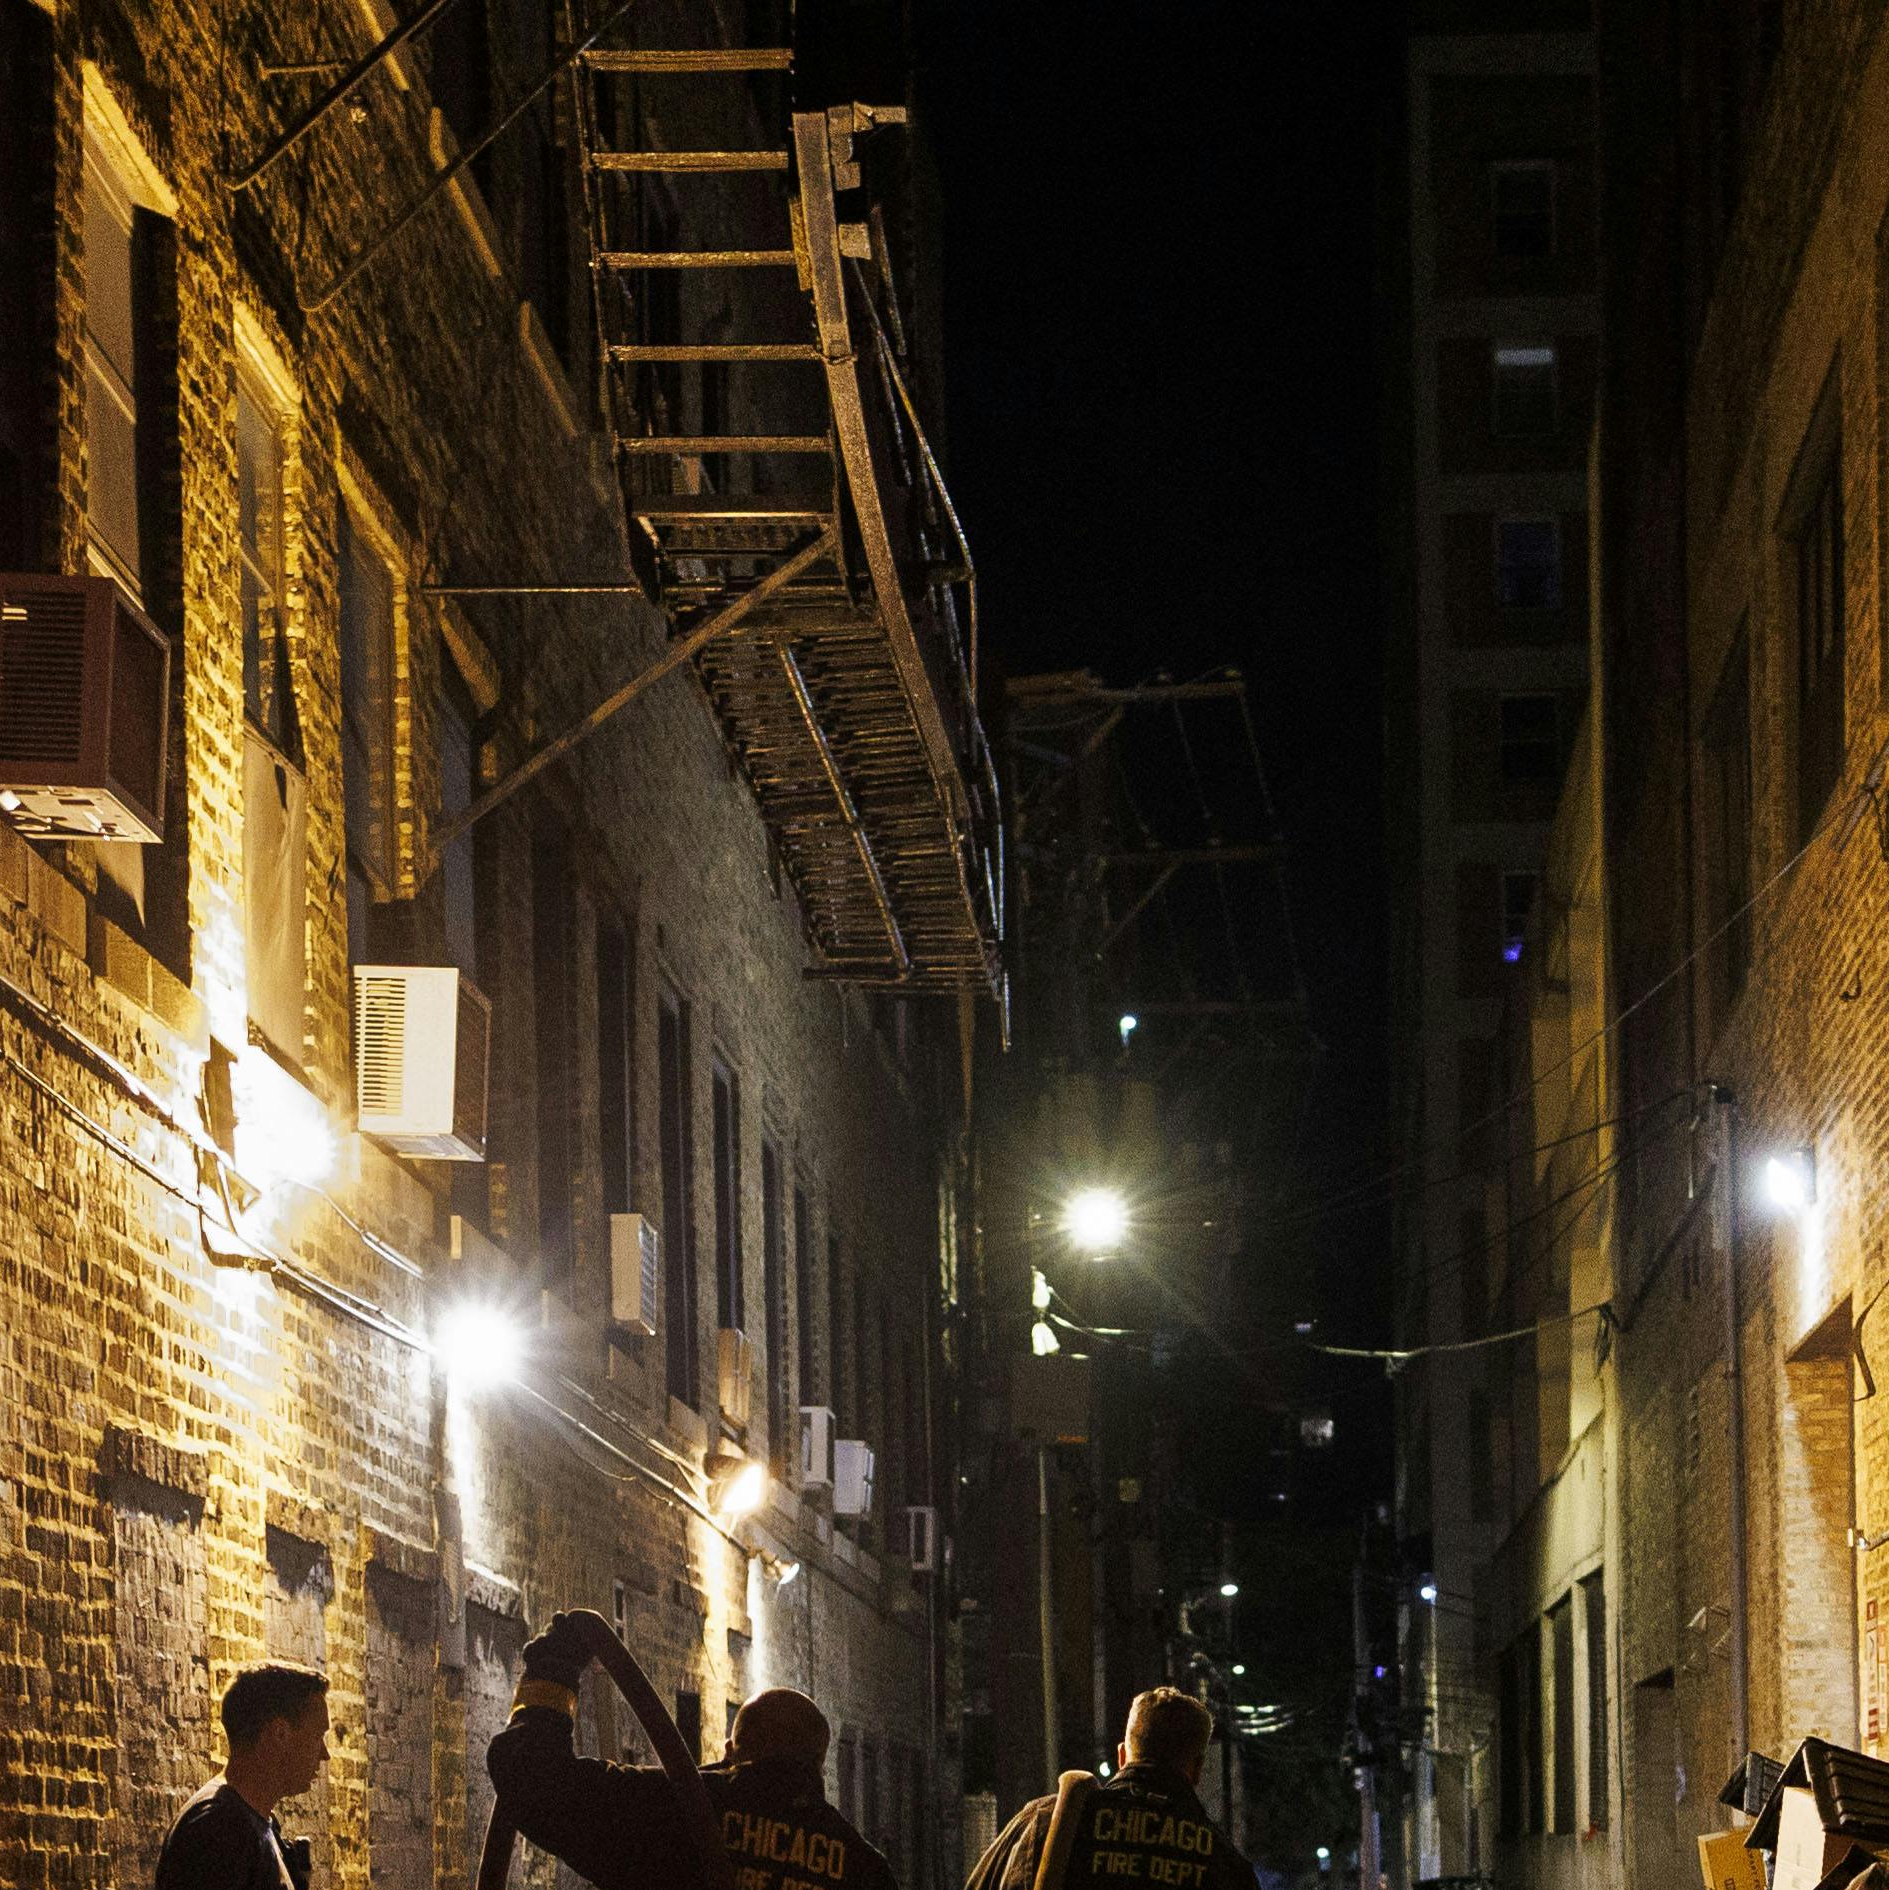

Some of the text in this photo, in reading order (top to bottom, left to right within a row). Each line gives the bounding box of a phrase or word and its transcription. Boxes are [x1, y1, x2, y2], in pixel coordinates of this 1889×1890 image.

[721, 1810, 846, 1881] CHICAGO
[1093, 1807, 1215, 1858] CHICAGO
[1092, 1850, 1209, 1890] FIRE DEPT
